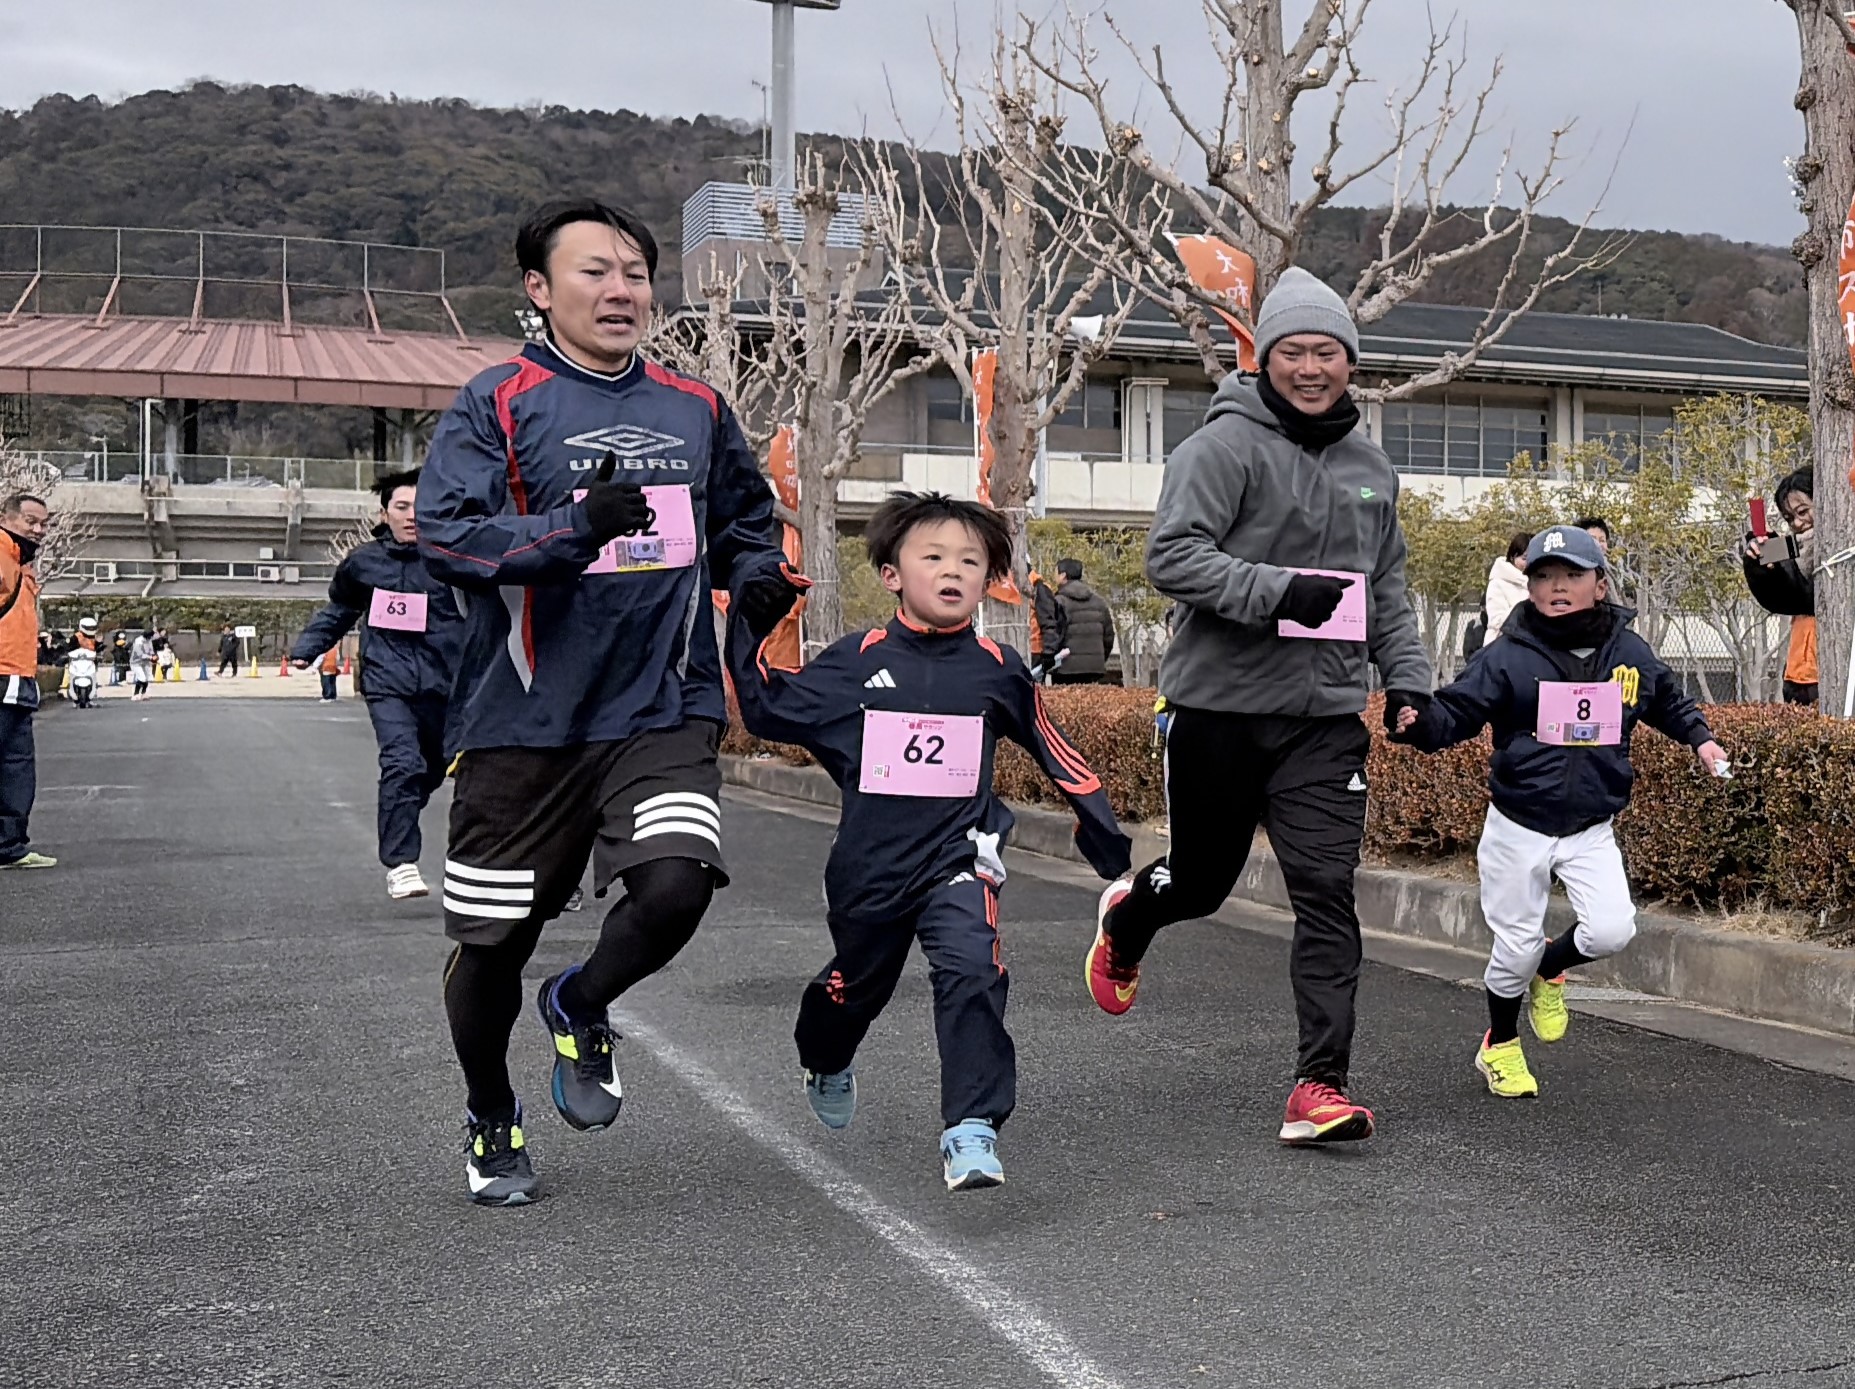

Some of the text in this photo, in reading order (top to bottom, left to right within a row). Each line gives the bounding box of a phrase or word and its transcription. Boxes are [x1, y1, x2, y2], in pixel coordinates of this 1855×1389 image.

[387, 600, 406, 616] 63
[1576, 698, 1591, 721] 8
[903, 734, 945, 765] 62
